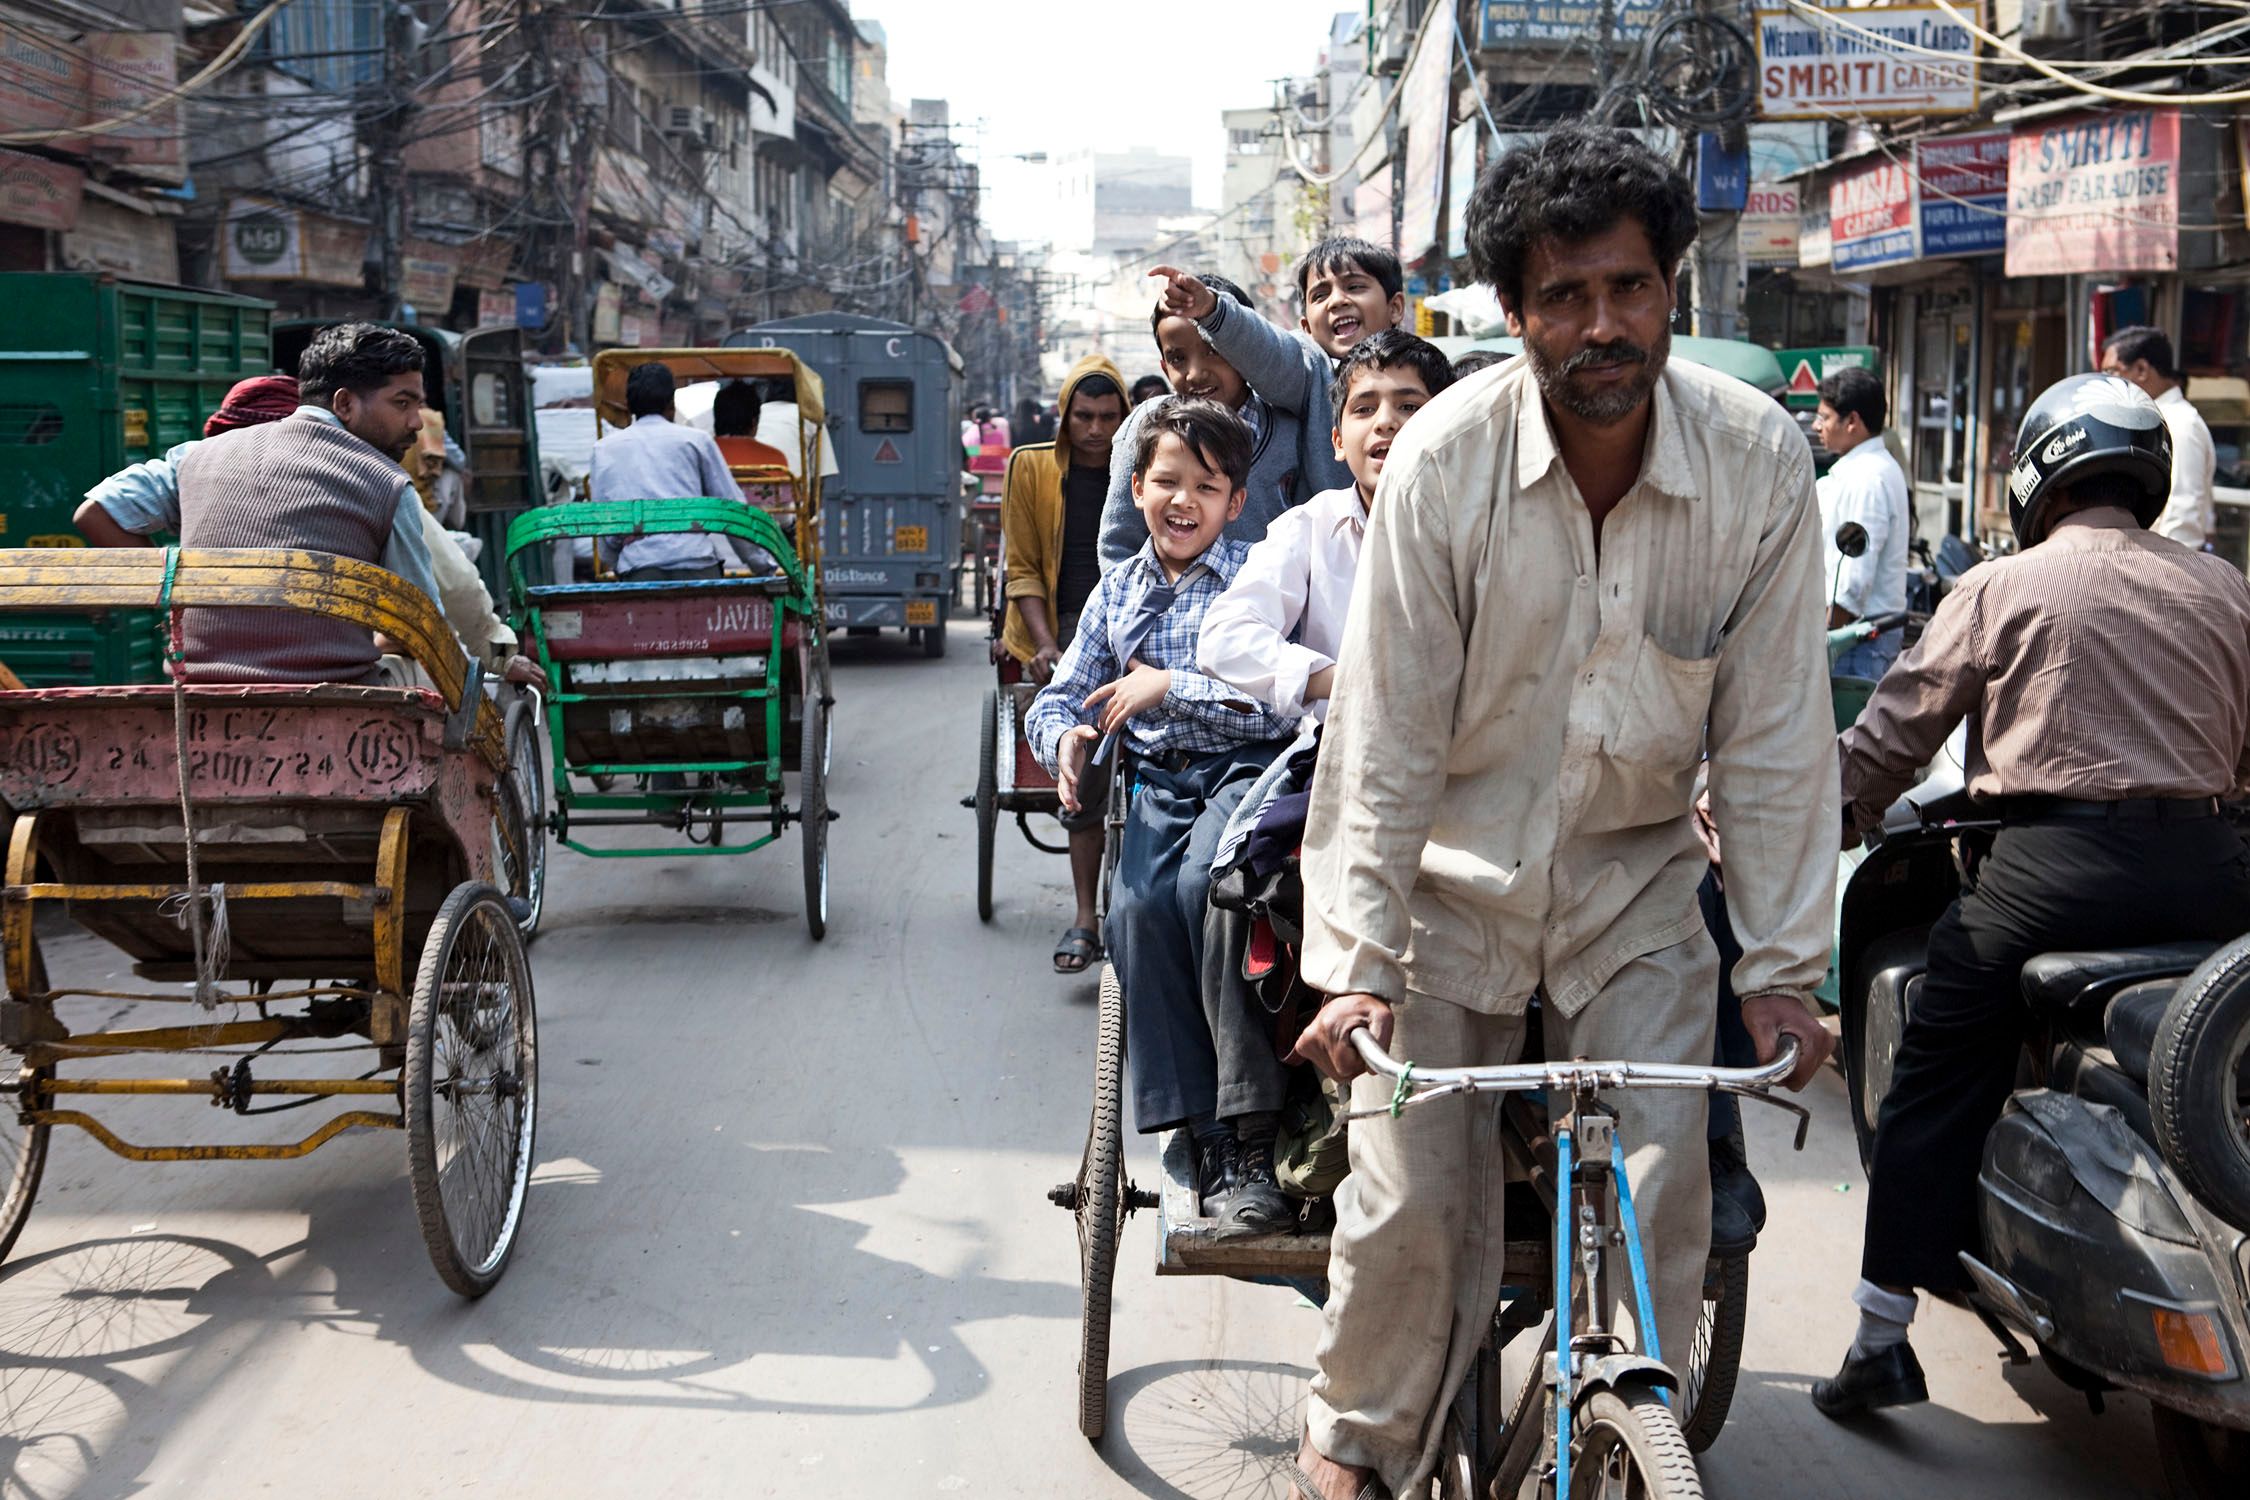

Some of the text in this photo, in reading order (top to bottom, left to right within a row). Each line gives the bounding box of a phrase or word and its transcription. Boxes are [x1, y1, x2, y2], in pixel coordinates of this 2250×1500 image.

[1921, 18, 1970, 51] CARDS
[1764, 62, 1969, 98] SMRITI CARDS
[360, 733, 403, 773] US
